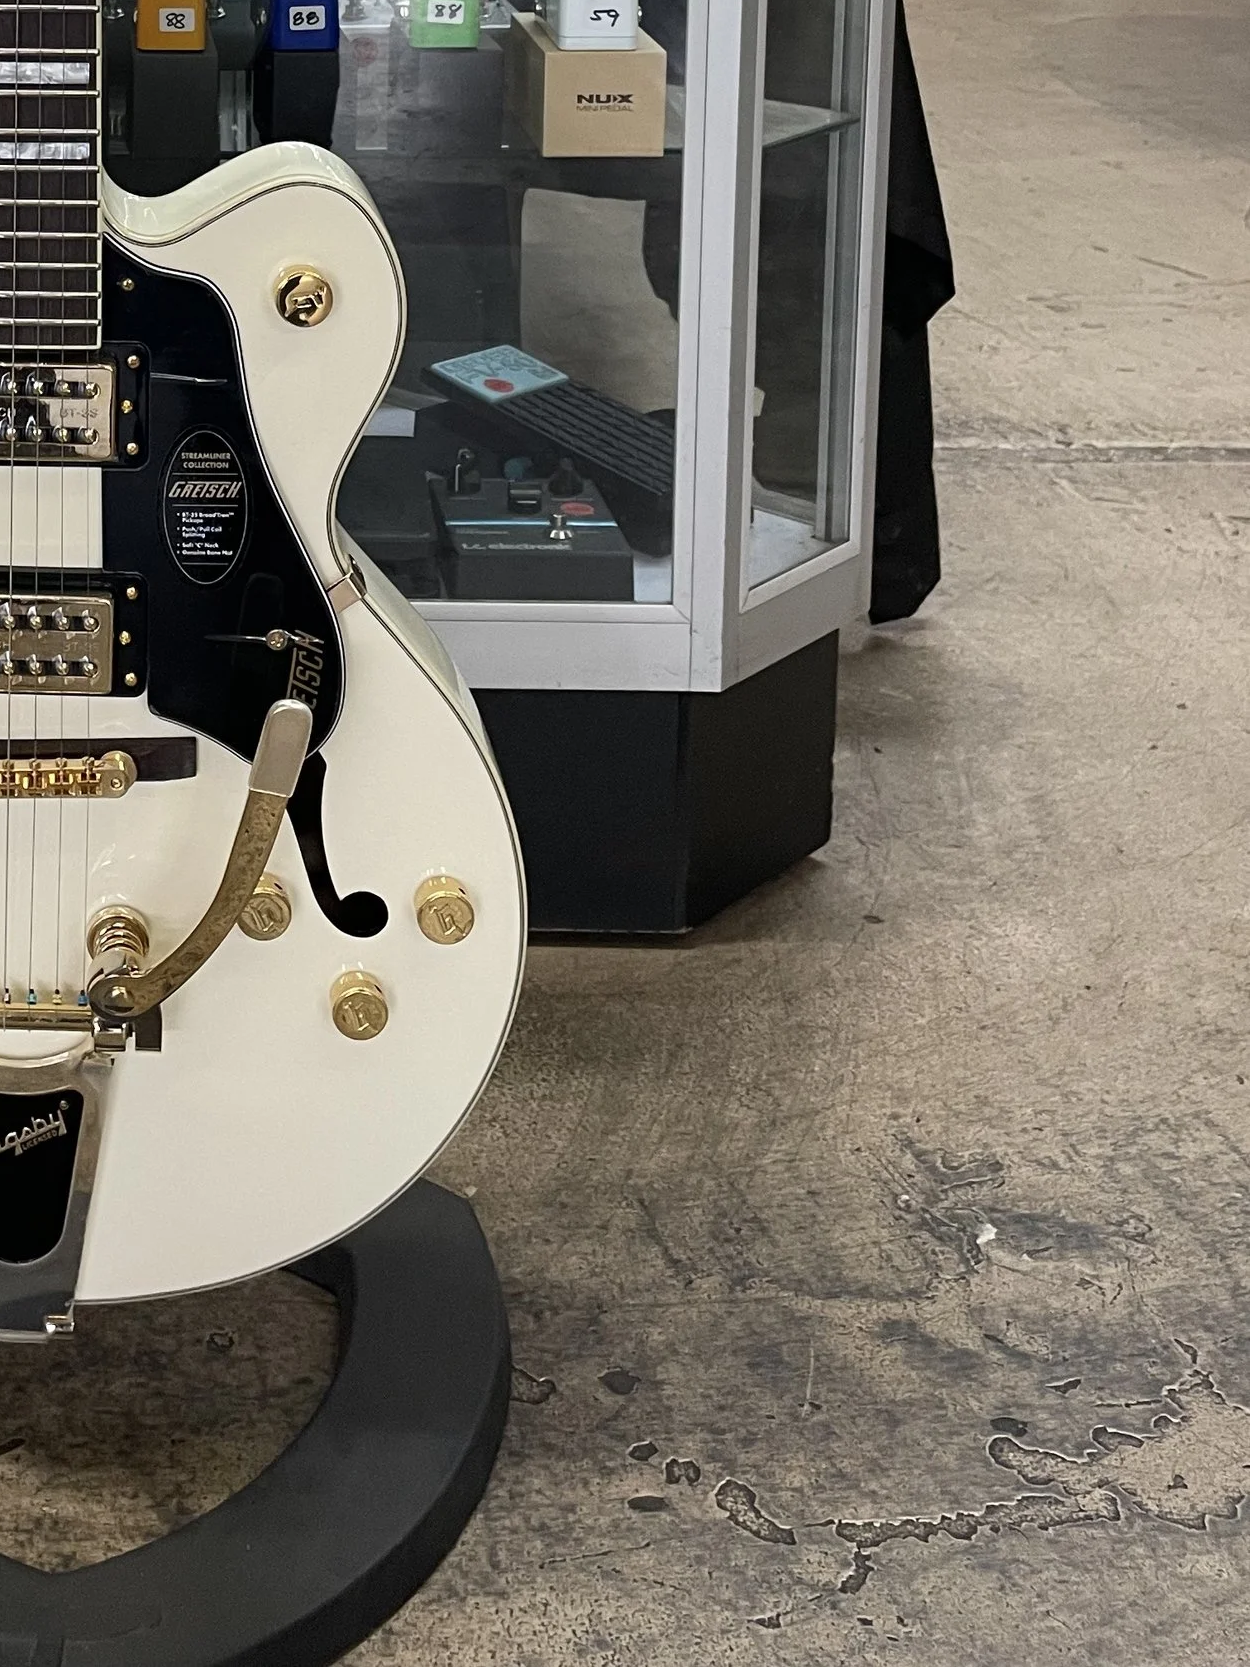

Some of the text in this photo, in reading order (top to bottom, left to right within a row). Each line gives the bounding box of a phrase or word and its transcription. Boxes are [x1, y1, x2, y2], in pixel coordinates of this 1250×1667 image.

[290, 11, 318, 26] 88
[435, 4, 461, 19] 88
[589, 8, 620, 28] 59
[164, 12, 186, 30] 88
[576, 93, 634, 104] NUX
[181, 451, 231, 460] STREAMLINER
[183, 461, 229, 469] COLLECTION
[168, 480, 243, 498] GRETSCH
[285, 629, 325, 711] ETSCH
